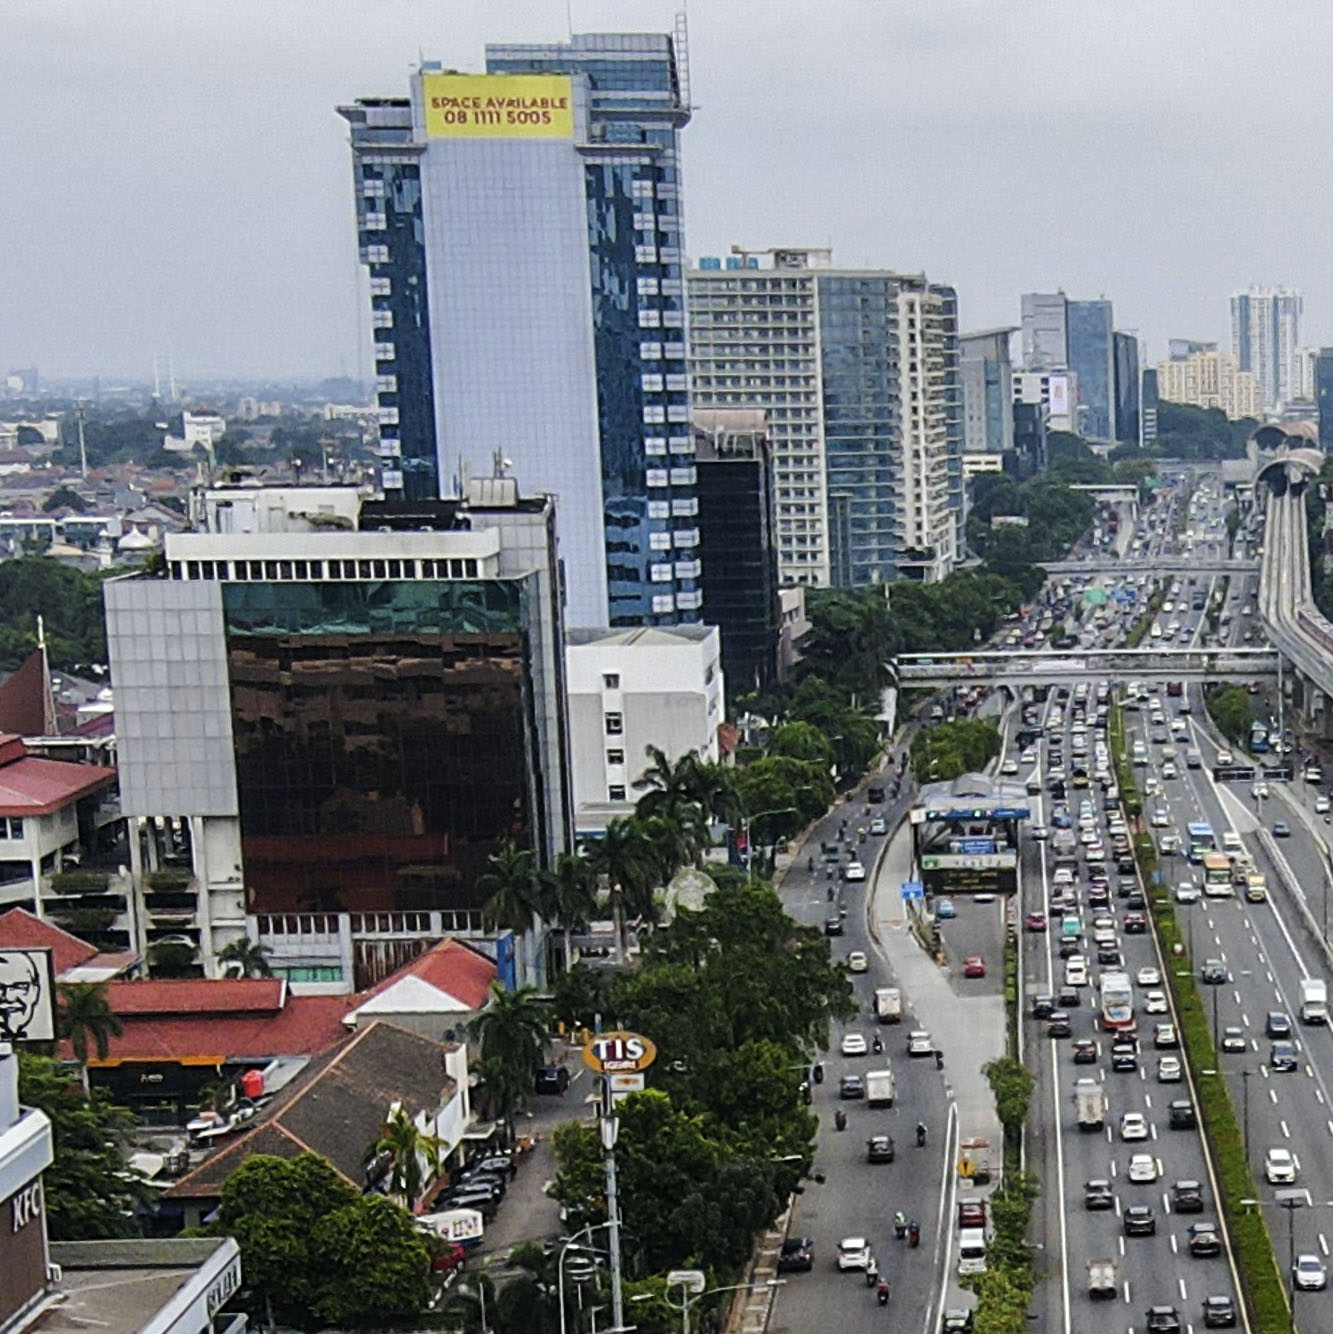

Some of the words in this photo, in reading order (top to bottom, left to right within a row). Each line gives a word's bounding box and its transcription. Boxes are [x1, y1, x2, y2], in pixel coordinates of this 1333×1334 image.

[431, 97, 481, 109] SPACE
[486, 97, 568, 109] AVAILABLE
[444, 110, 467, 124] 08
[474, 111, 500, 125] 1111
[506, 111, 552, 124] 5005
[594, 1038, 643, 1059] TIS
[13, 1182, 41, 1233] KFC
